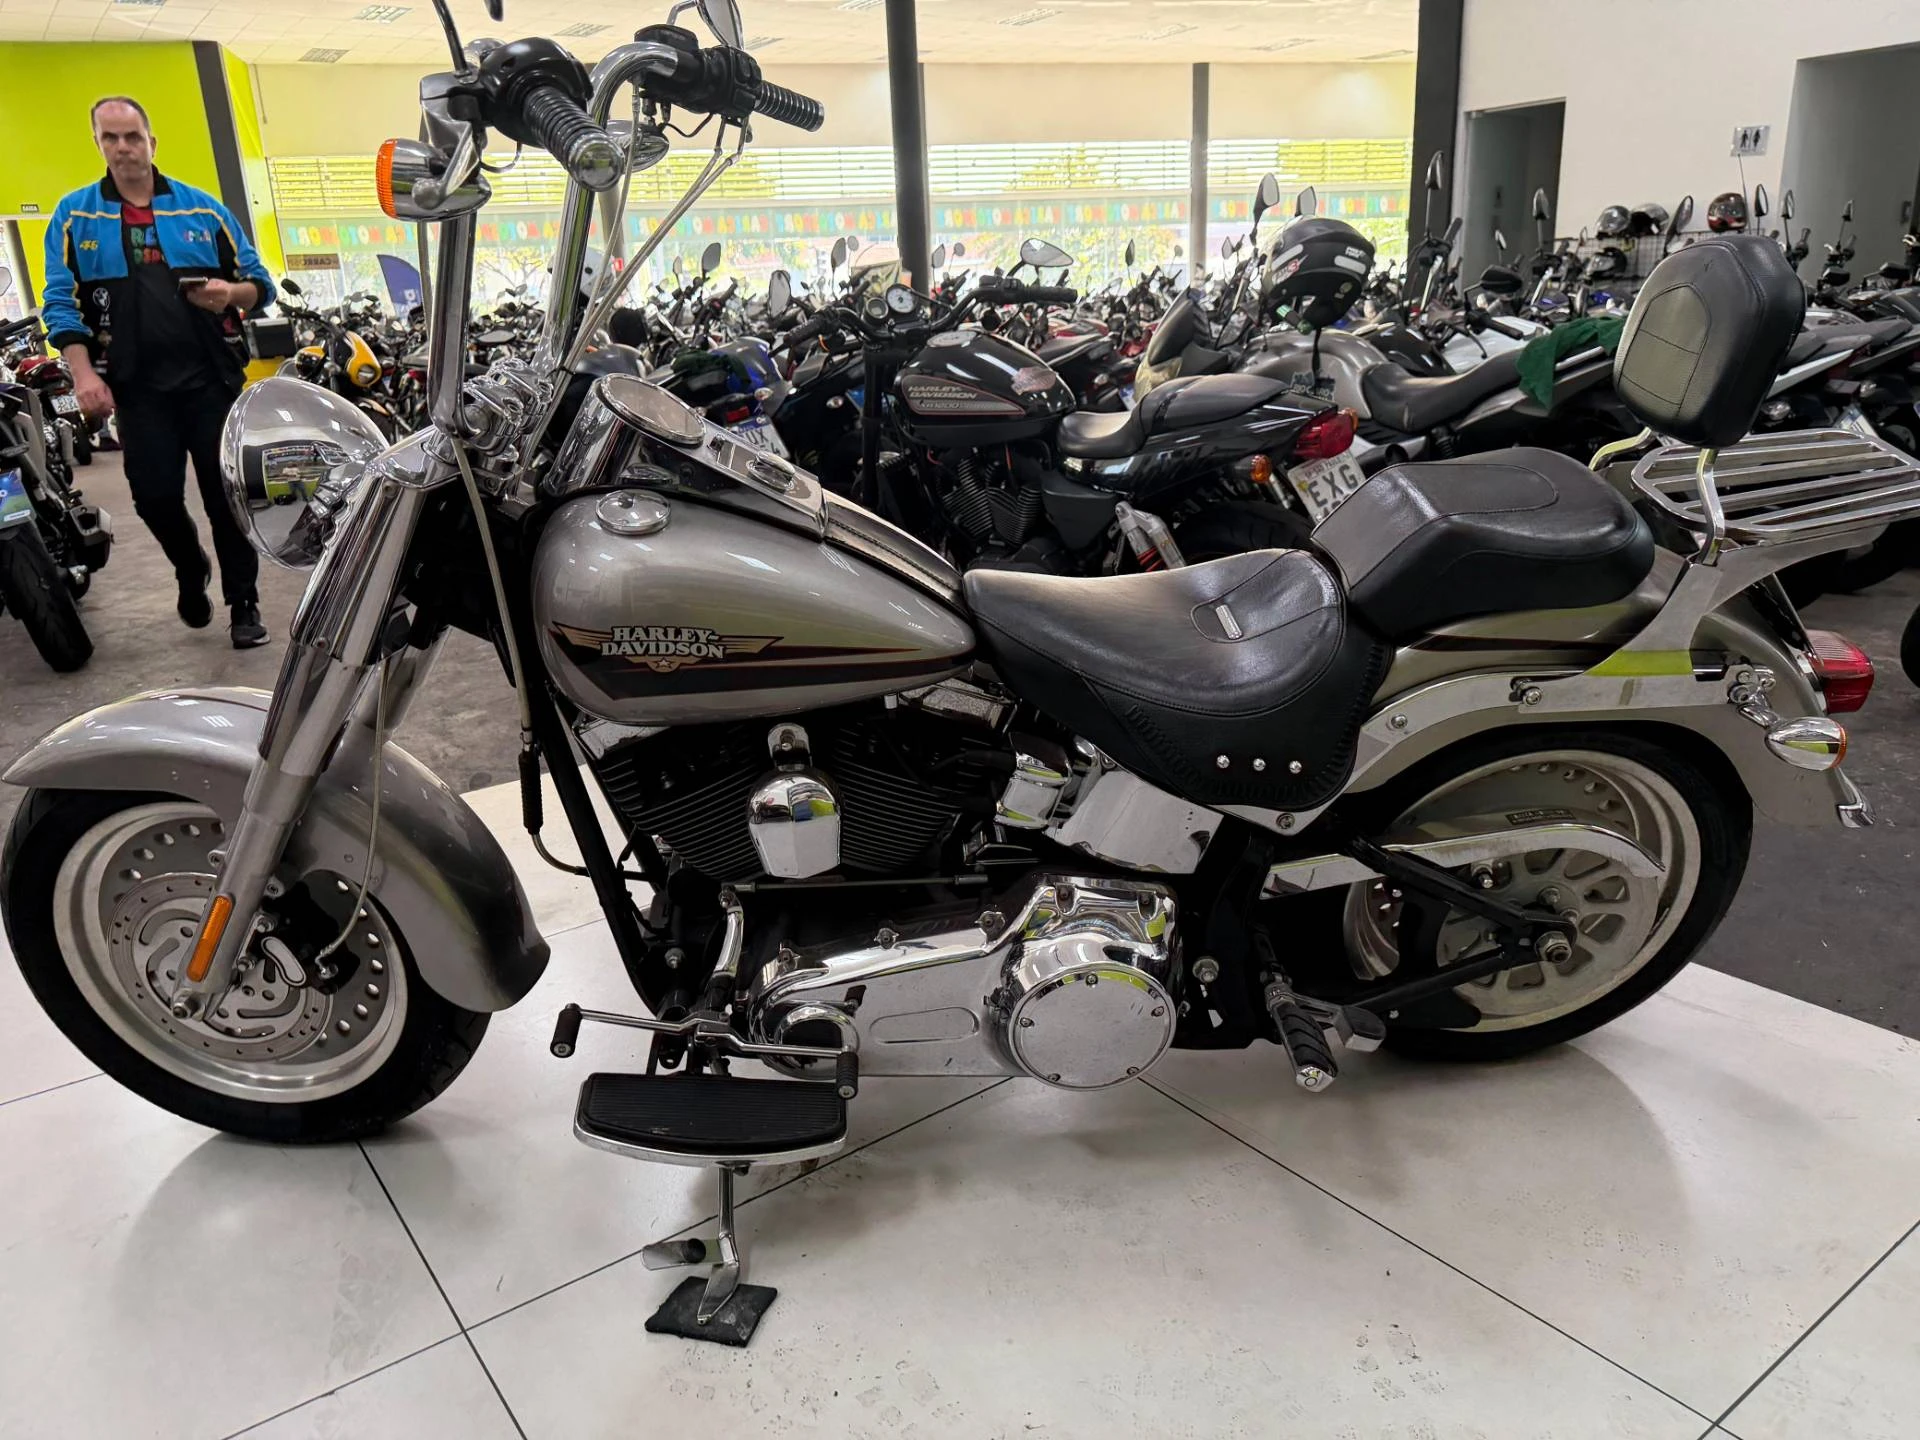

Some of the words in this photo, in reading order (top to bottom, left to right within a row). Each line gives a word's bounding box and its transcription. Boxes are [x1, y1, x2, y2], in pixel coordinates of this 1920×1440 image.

[909, 391, 977, 399] DAVIDSON
[1308, 463, 1359, 508] EXG
[612, 627, 720, 643] HARLEY-
[601, 641, 725, 659] DAVIDSON
